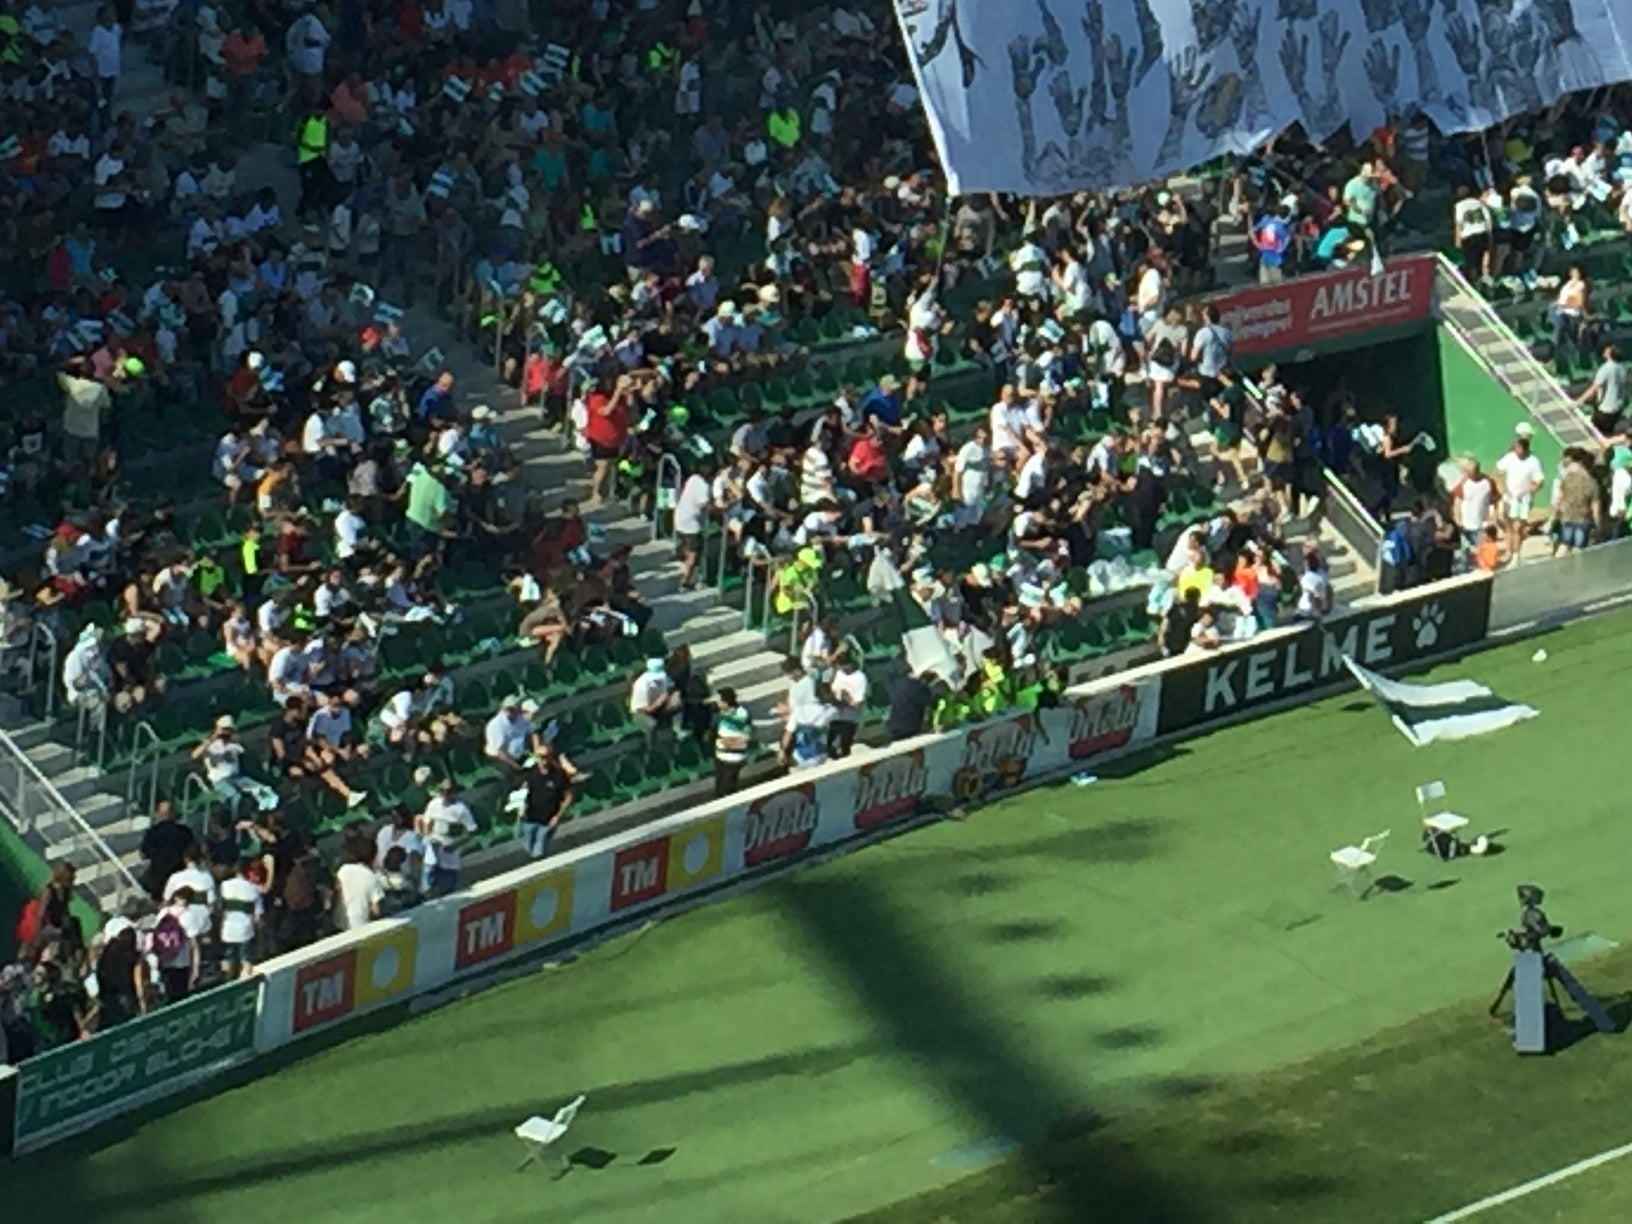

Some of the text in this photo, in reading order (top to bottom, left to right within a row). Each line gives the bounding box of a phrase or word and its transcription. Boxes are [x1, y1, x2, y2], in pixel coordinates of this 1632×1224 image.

[1310, 268, 1413, 319] AMSTEL
[1203, 612, 1397, 713] KELME
[619, 855, 660, 897] TM
[464, 908, 506, 954] TM
[303, 970, 345, 1016] TM
